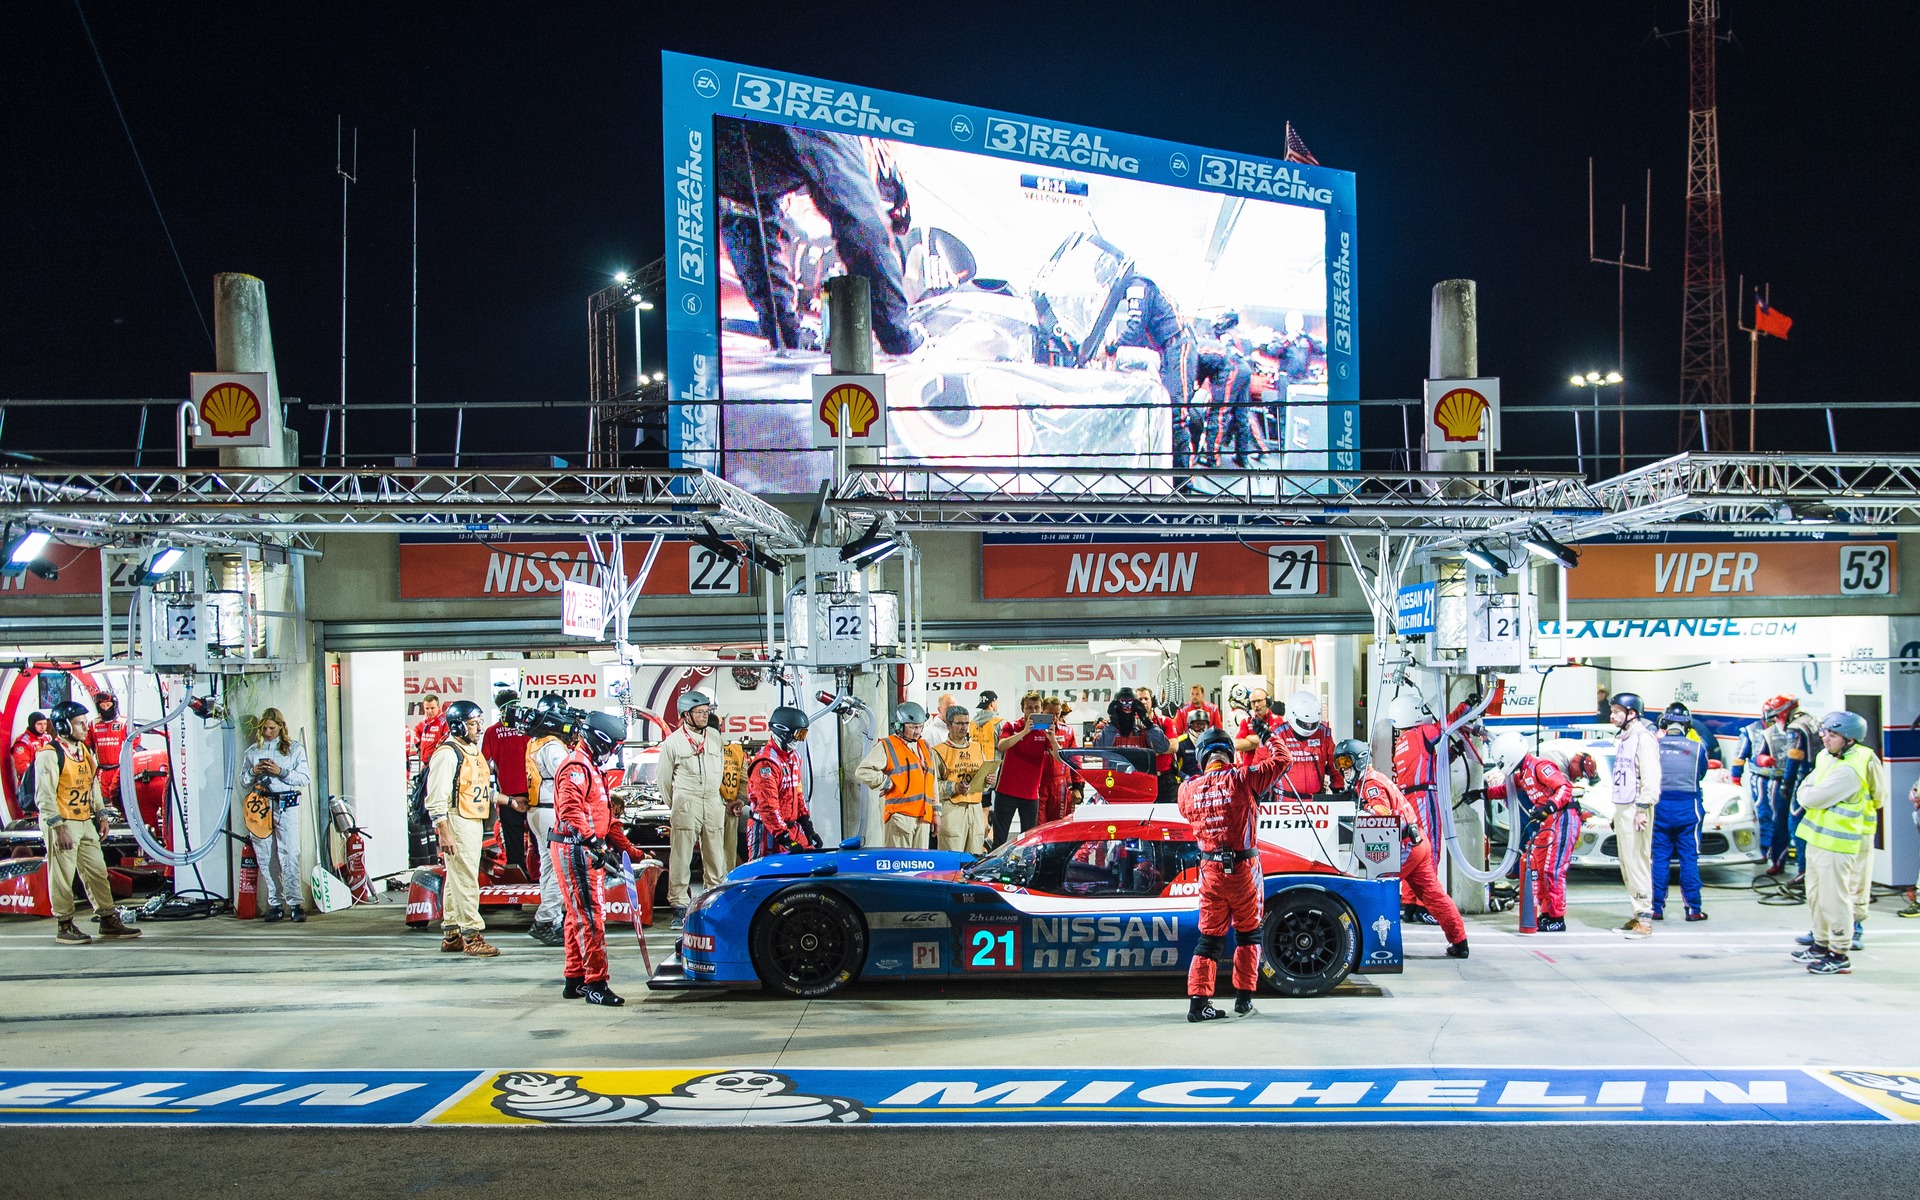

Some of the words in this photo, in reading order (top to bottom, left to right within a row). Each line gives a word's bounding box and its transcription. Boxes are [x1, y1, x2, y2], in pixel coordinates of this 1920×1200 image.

[697, 76, 717, 91] EA
[741, 79, 772, 110] 3
[787, 81, 880, 114] REAL
[784, 99, 915, 138] RACING
[954, 121, 971, 135] EA
[991, 123, 1017, 151] 3
[1030, 124, 1110, 153] REAL
[1028, 140, 1140, 174] RACING
[1204, 160, 1227, 186] 3
[1238, 160, 1307, 185] REAL
[689, 130, 704, 244] RACING
[1236, 175, 1332, 204] RACING
[676, 159, 690, 238] REAL
[1340, 231, 1351, 322] RACING
[1333, 256, 1342, 319] REAL
[693, 354, 708, 465] RACING
[682, 383, 695, 466] REAL
[690, 551, 738, 590] 22
[1065, 551, 1199, 594] NISSAN
[1272, 549, 1316, 590] 21
[1653, 551, 1759, 594] VIPER
[1843, 549, 1887, 590] 53
[566, 589, 577, 627] 22
[1399, 590, 1423, 611] NISSAN
[1424, 588, 1435, 627] 21
[835, 616, 862, 636] 22
[1399, 612, 1423, 631] nismo
[1497, 618, 1520, 637] 21
[526, 673, 597, 686] NISSAN
[927, 666, 978, 678] SSAN
[1025, 663, 1137, 682] NISSAN
[404, 677, 463, 694] SAN
[1502, 696, 1536, 706] ANGE
[721, 715, 770, 733] ISS
[68, 789, 89, 806] 24
[473, 786, 489, 803] 24
[1194, 788, 1230, 801] NISSAN
[1194, 797, 1232, 809] nismo
[1259, 805, 1329, 816] NISSAN
[1259, 819, 1329, 830] nismo
[1357, 817, 1397, 828] MOTUL
[878, 861, 890, 869] 21
[892, 860, 935, 870] @NISMO
[1367, 851, 1388, 861] HEUER
[311, 876, 322, 901] 22
[323, 870, 331, 910] START
[1169, 883, 1200, 896] MOT
[0, 896, 35, 907] OTUL
[406, 902, 432, 915] OTUL
[604, 902, 643, 915] MOTL
[902, 912, 939, 922] WEC
[1032, 916, 1178, 943] NISSAN
[684, 933, 713, 950] MOTUL
[971, 929, 1014, 966] 21
[917, 946, 936, 965] P1
[1033, 947, 1178, 968] nismo
[687, 962, 716, 971] MICHELIN
[0, 1082, 428, 1106] ELIN
[878, 1080, 1788, 1105] MICHELIN
